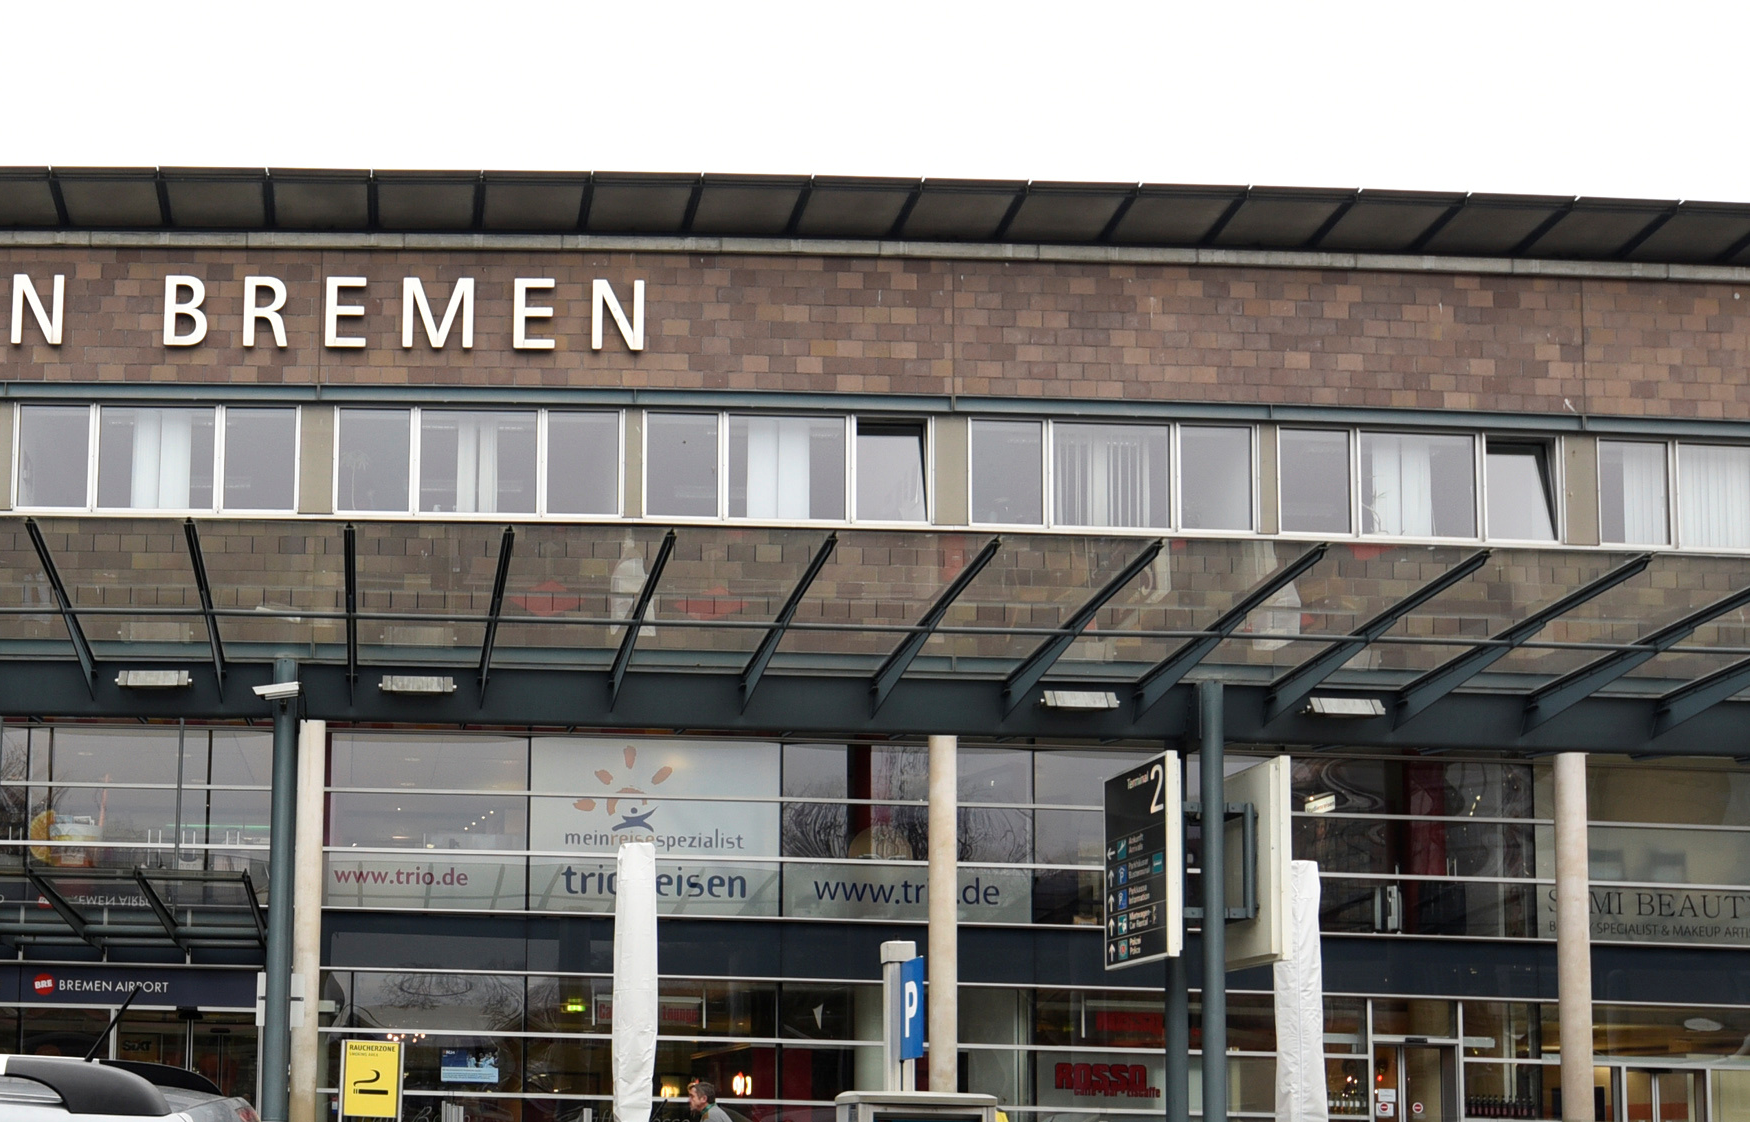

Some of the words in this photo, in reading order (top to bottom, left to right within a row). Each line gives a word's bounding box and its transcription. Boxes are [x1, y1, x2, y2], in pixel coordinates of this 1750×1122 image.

[162, 275, 646, 351] BREMEN
[1126, 770, 1149, 790] Terminal
[1150, 764, 1164, 814] 2
[333, 866, 469, 886] www.trio.de
[656, 866, 747, 898] eisen
[1547, 889, 1624, 916] SMI
[1636, 892, 1750, 920] BEAUT
[1596, 922, 1658, 936] SPECIALIST
[1661, 924, 1670, 936] &
[1672, 926, 1721, 937] MAKEUP
[1724, 927, 1750, 938] ARTI
[34, 979, 53, 990] BRE
[58, 979, 112, 992] BREMEN
[115, 981, 169, 993] AIRPORT
[905, 981, 918, 1038] P
[349, 1044, 396, 1053] RAUCHERZONE
[1055, 1063, 1147, 1092] ROSSO
